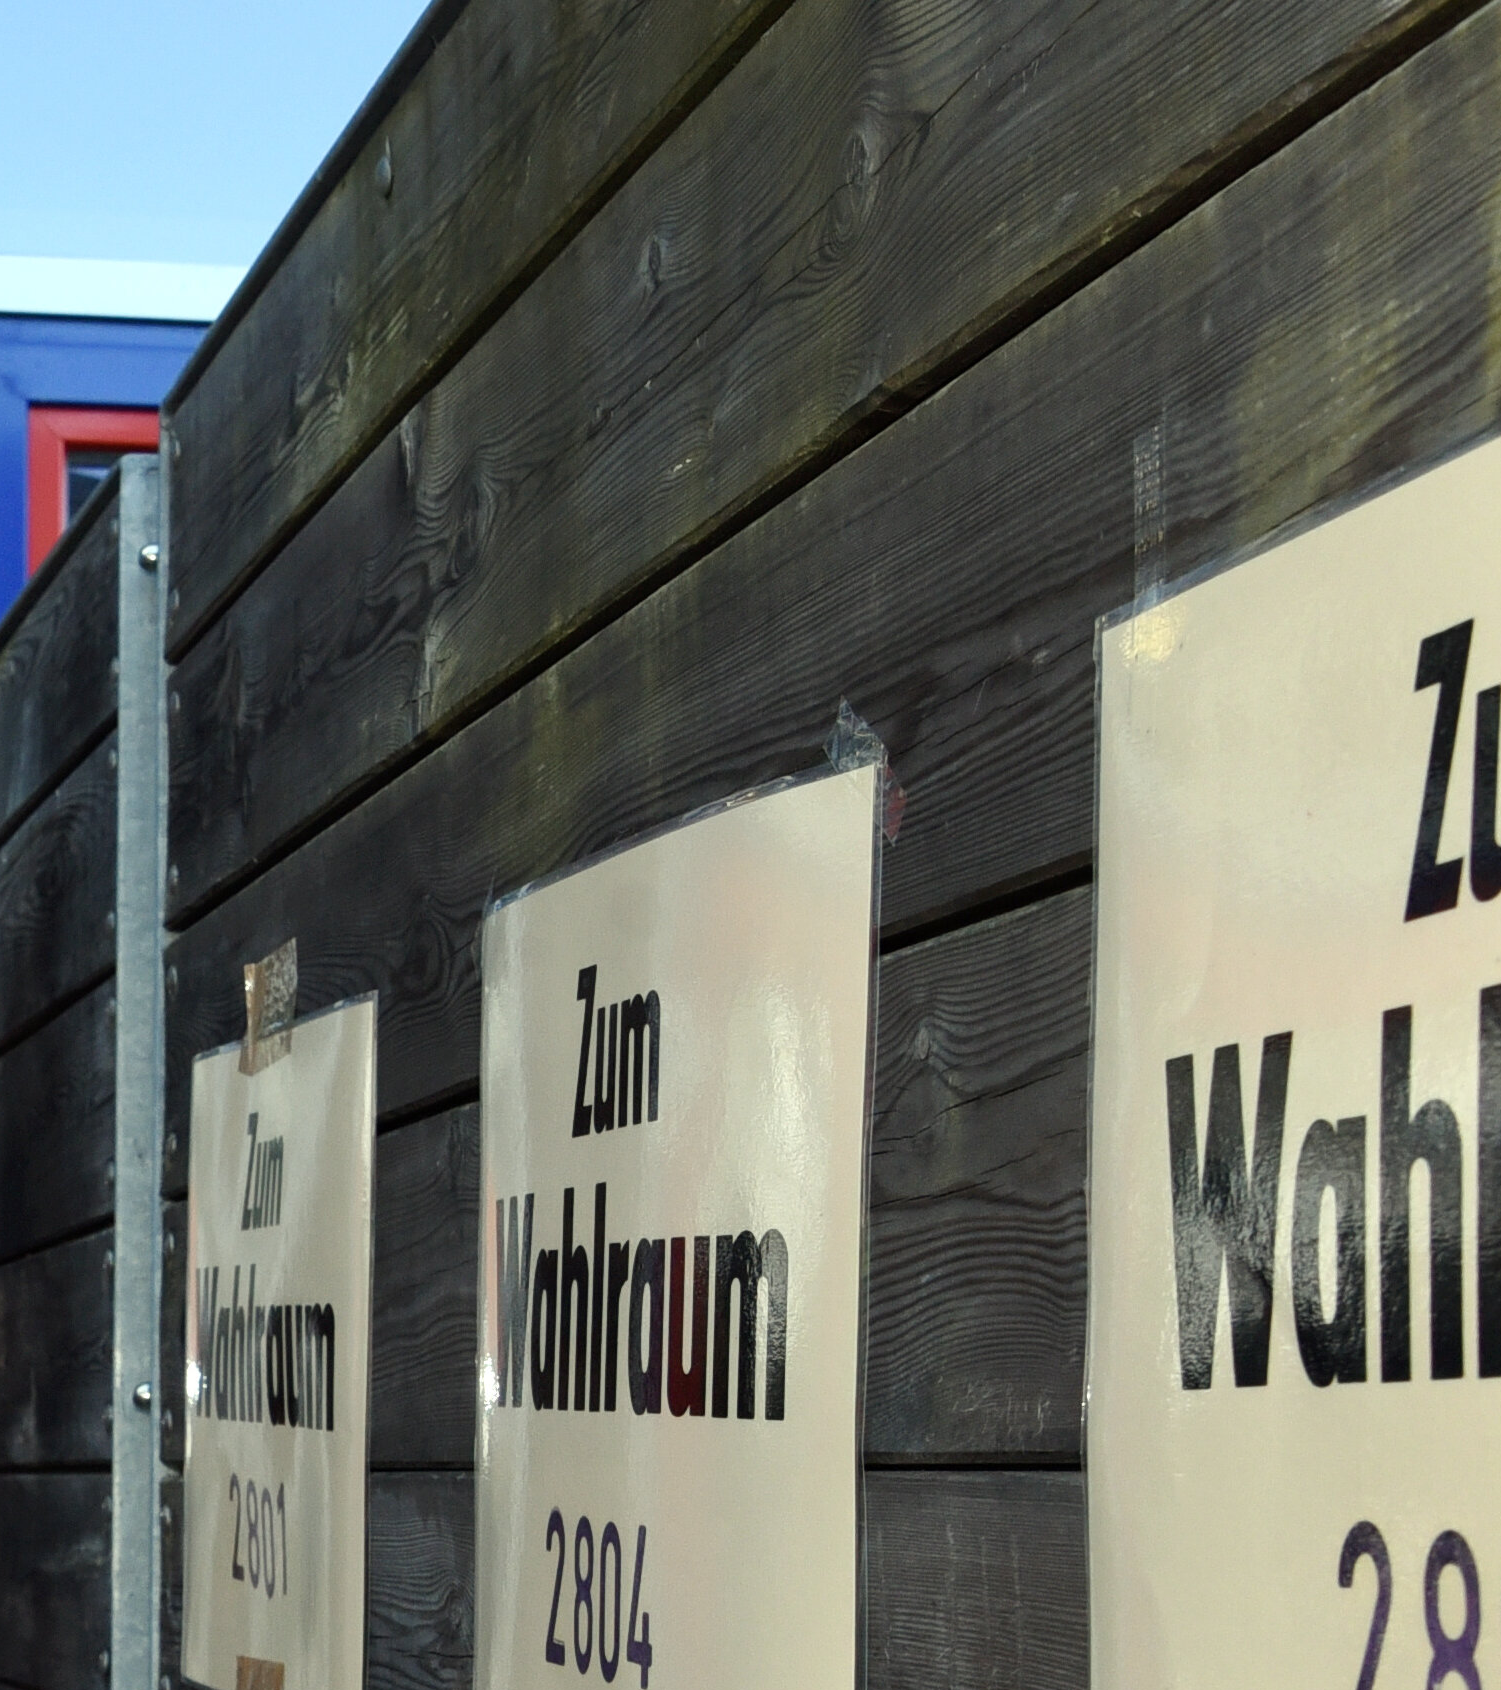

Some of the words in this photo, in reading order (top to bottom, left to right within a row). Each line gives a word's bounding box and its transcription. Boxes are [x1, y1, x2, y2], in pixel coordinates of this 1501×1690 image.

[572, 964, 659, 1139] Zum
[242, 1112, 284, 1231] Zum
[196, 1263, 335, 1432] Wahlraum
[495, 1182, 790, 1422] Wahlraum
[229, 1473, 288, 1599] 2801
[545, 1507, 653, 1690] 2804
